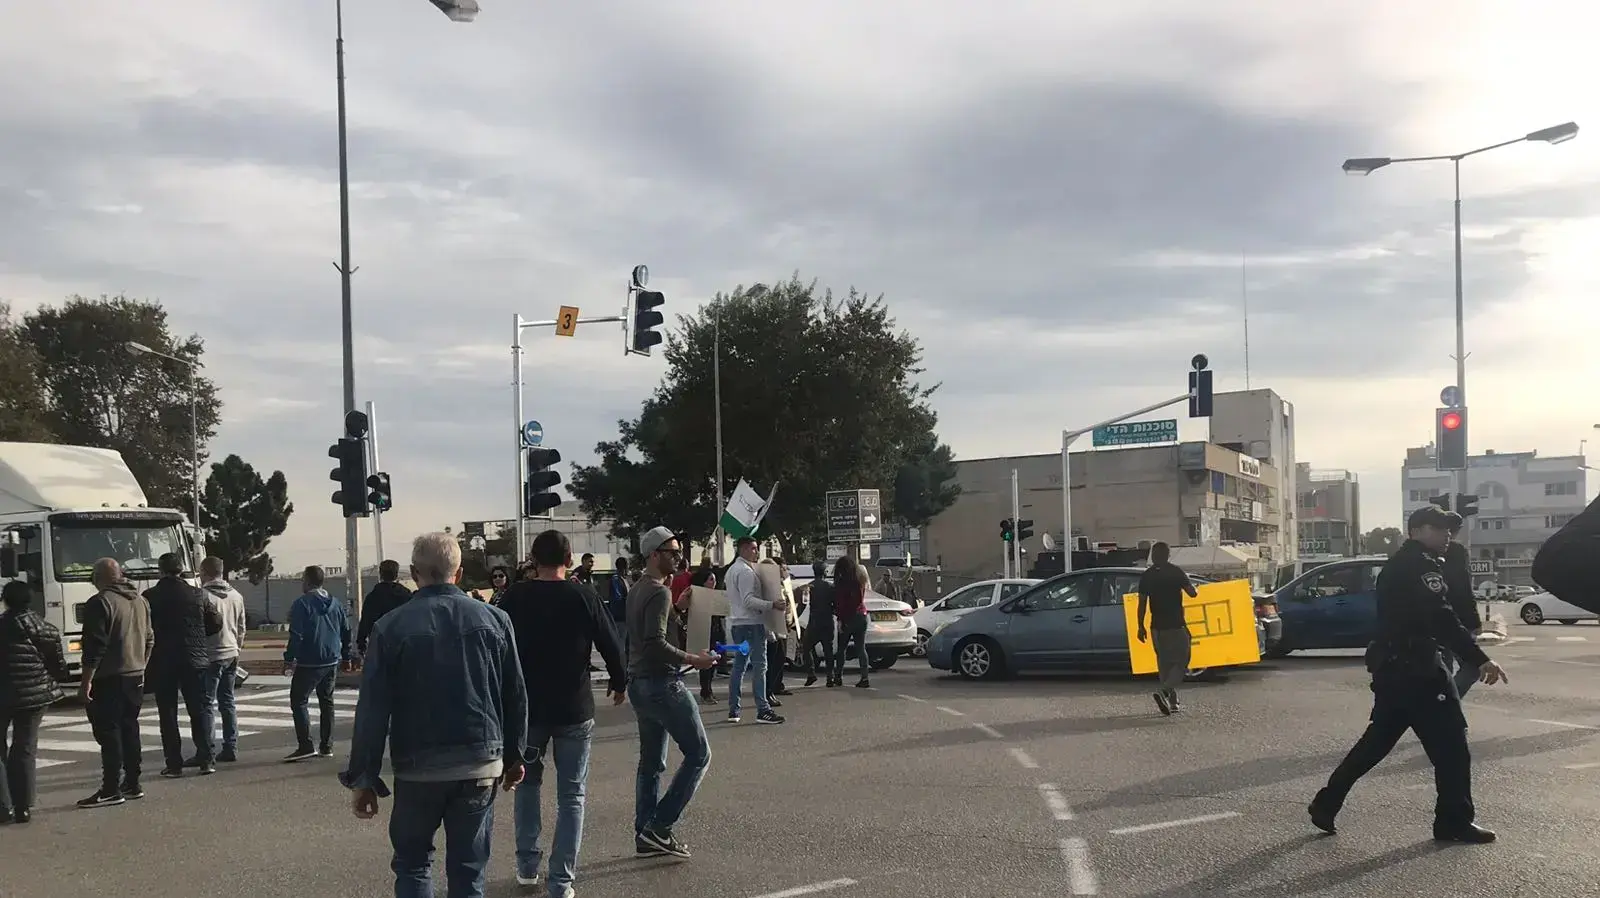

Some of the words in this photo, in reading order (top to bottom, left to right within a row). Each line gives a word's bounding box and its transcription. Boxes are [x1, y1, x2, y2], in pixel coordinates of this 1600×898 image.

[562, 313, 572, 330] 3
[1133, 421, 1175, 433] סוכנות
[1470, 562, 1488, 572] ORM
